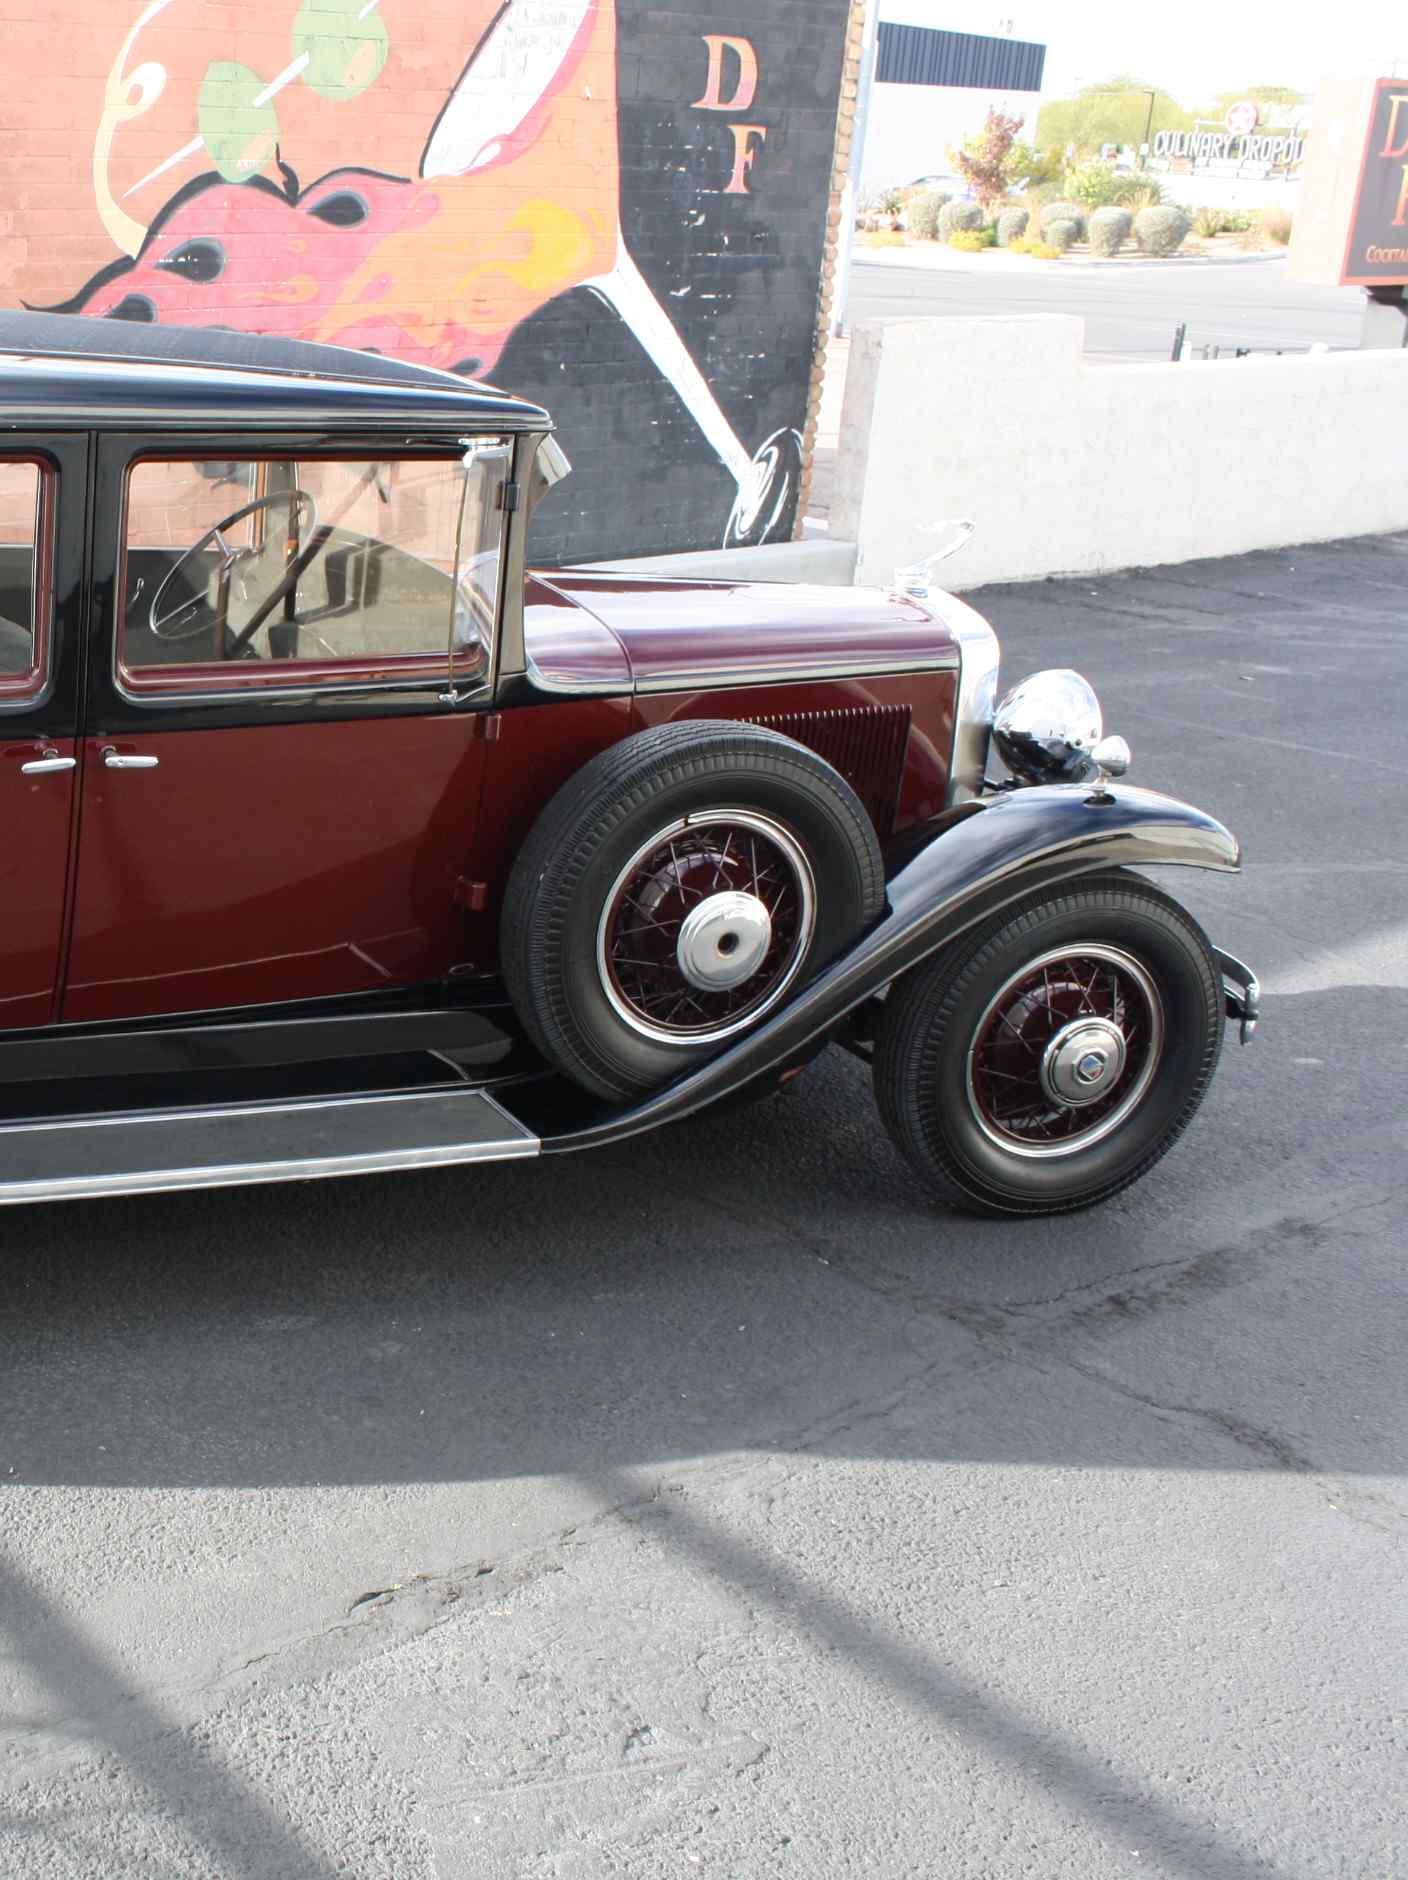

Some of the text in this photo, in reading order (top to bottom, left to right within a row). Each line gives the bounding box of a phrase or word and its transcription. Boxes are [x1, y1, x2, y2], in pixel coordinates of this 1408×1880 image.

[690, 34, 759, 111] D
[723, 123, 768, 194] F
[1154, 129, 1235, 160] CULINARY
